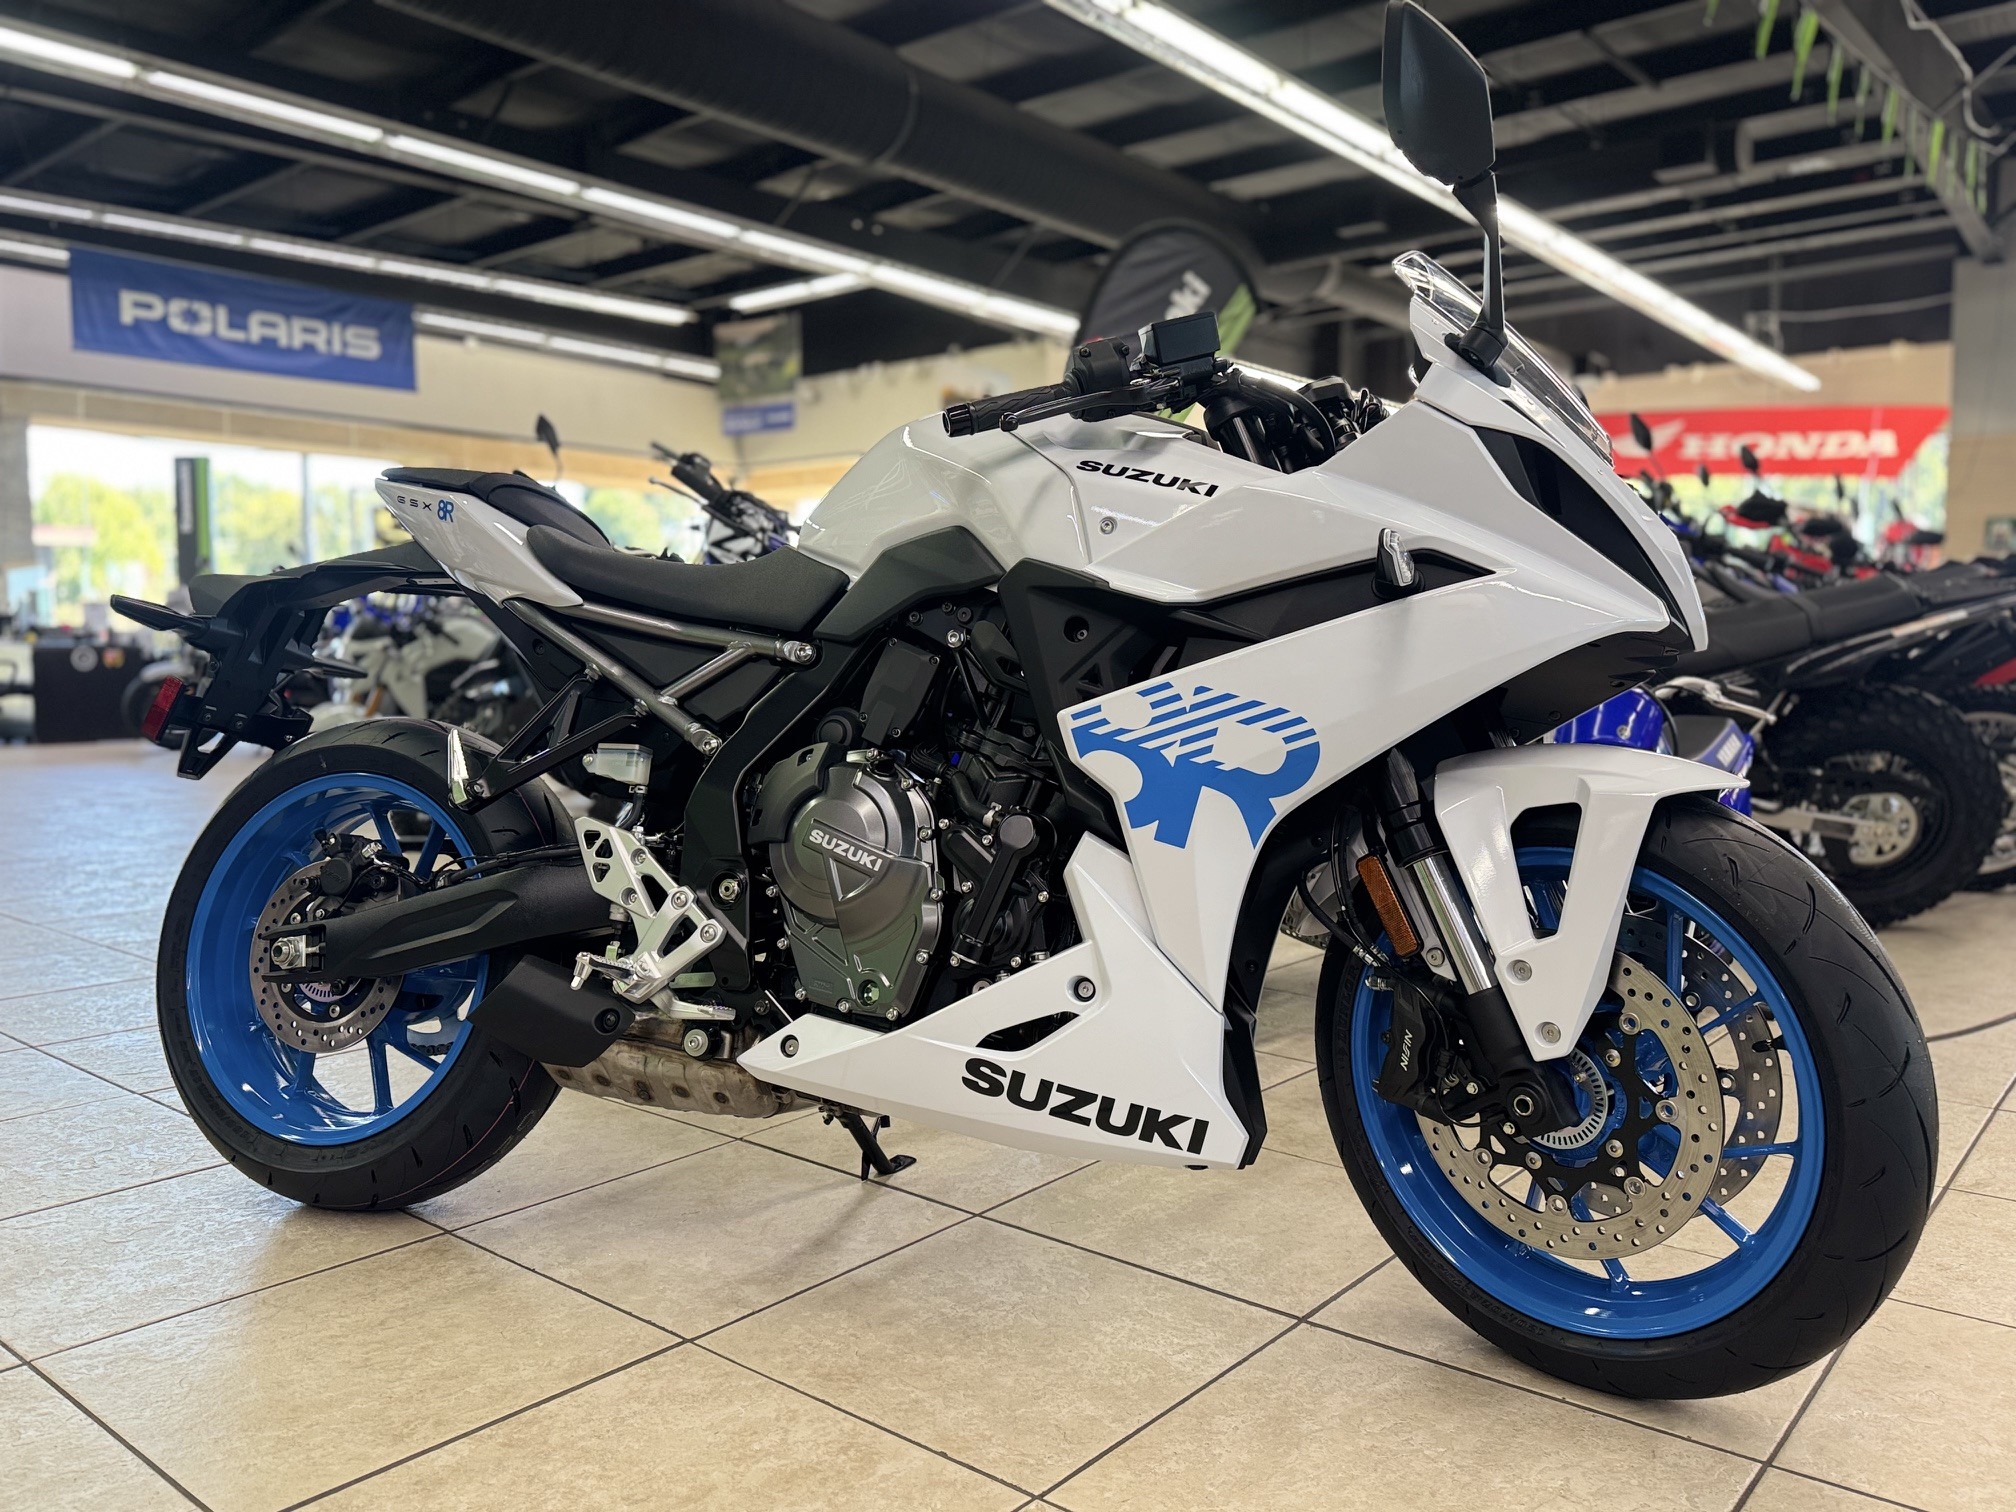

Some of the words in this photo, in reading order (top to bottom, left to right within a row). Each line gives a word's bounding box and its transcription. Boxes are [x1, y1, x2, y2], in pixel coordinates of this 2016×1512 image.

[120, 290, 382, 360] POLARIS
[1682, 429, 1897, 460] HONDA
[1076, 459, 1219, 498] SUZUKI
[437, 499, 455, 523] 8R
[809, 829, 882, 872] SUZUKI
[962, 1058, 1210, 1155] SUZUKI
